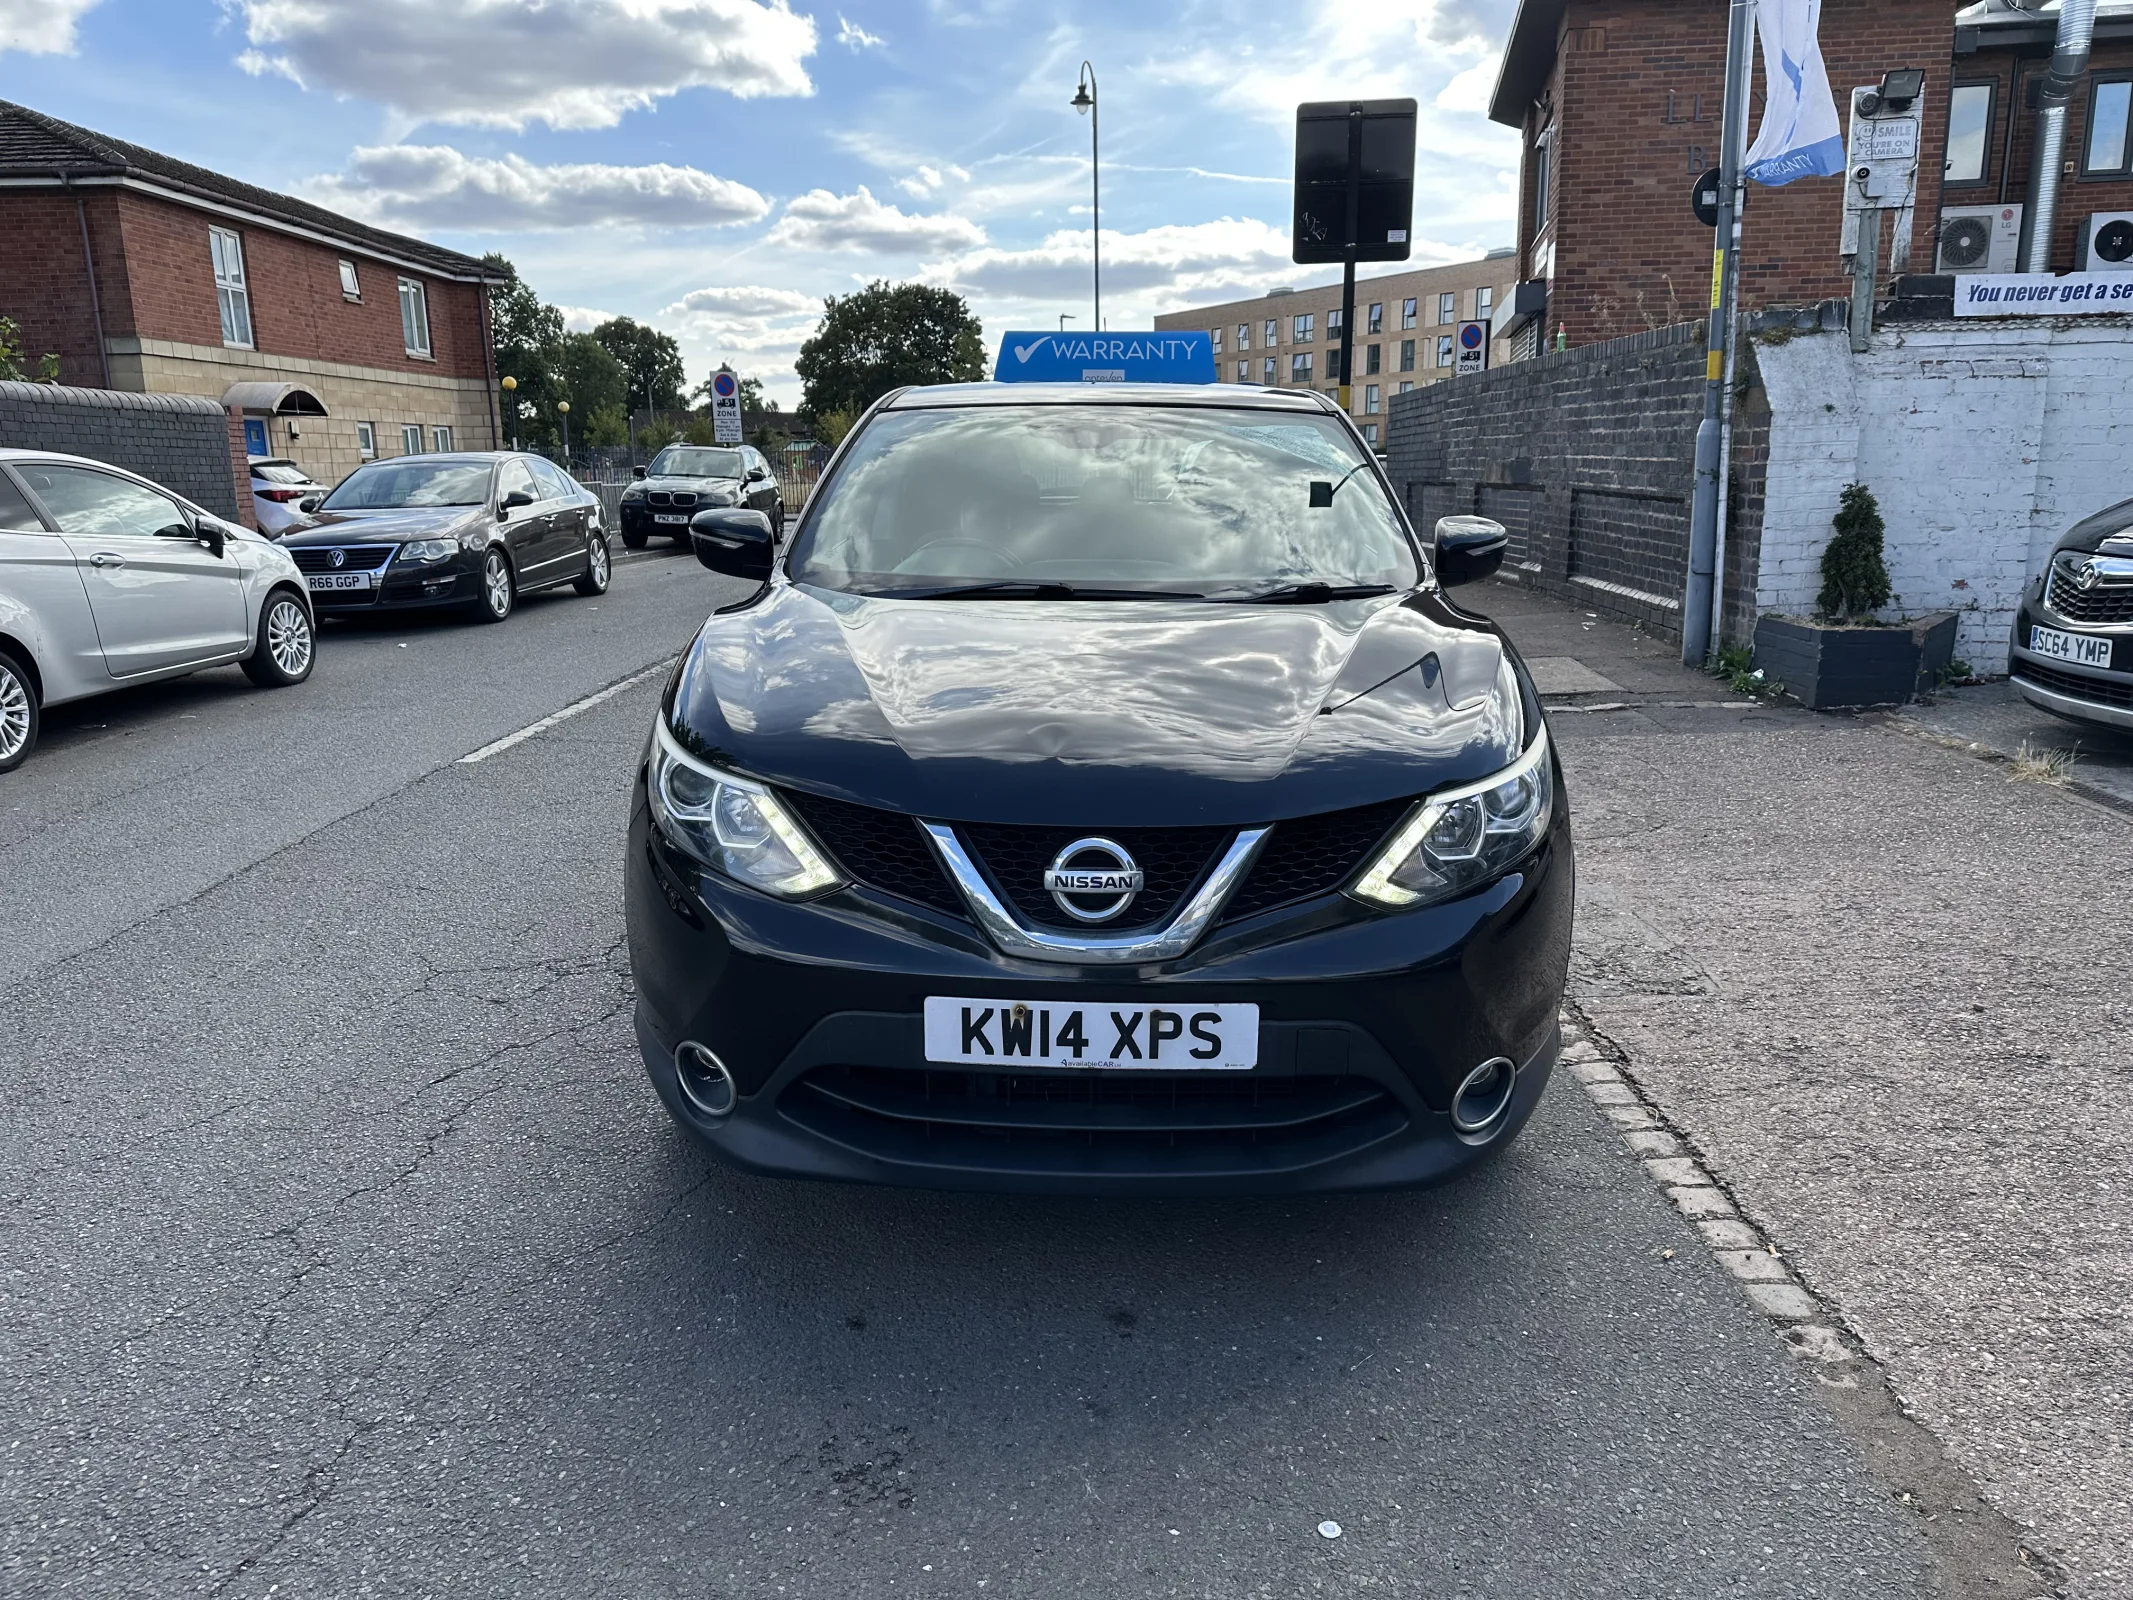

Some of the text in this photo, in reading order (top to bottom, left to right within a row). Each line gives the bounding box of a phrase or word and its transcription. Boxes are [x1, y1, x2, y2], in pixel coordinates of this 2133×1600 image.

[1878, 126, 1912, 138] SMILE
[1858, 141, 1892, 149] YOU'RE
[1865, 148, 1903, 156] CAMERA
[1968, 285, 2001, 302] You
[2003, 285, 2058, 302] never
[2060, 283, 2093, 302] get
[2095, 285, 2108, 300] a
[1051, 340, 1198, 360] WARRANTY
[309, 576, 360, 588] R66 GGP
[2037, 630, 2069, 656] SC64
[2075, 638, 2109, 662] YMP
[1054, 875, 1133, 888] NISSAN
[961, 1006, 1222, 1060] KW14 XPS
